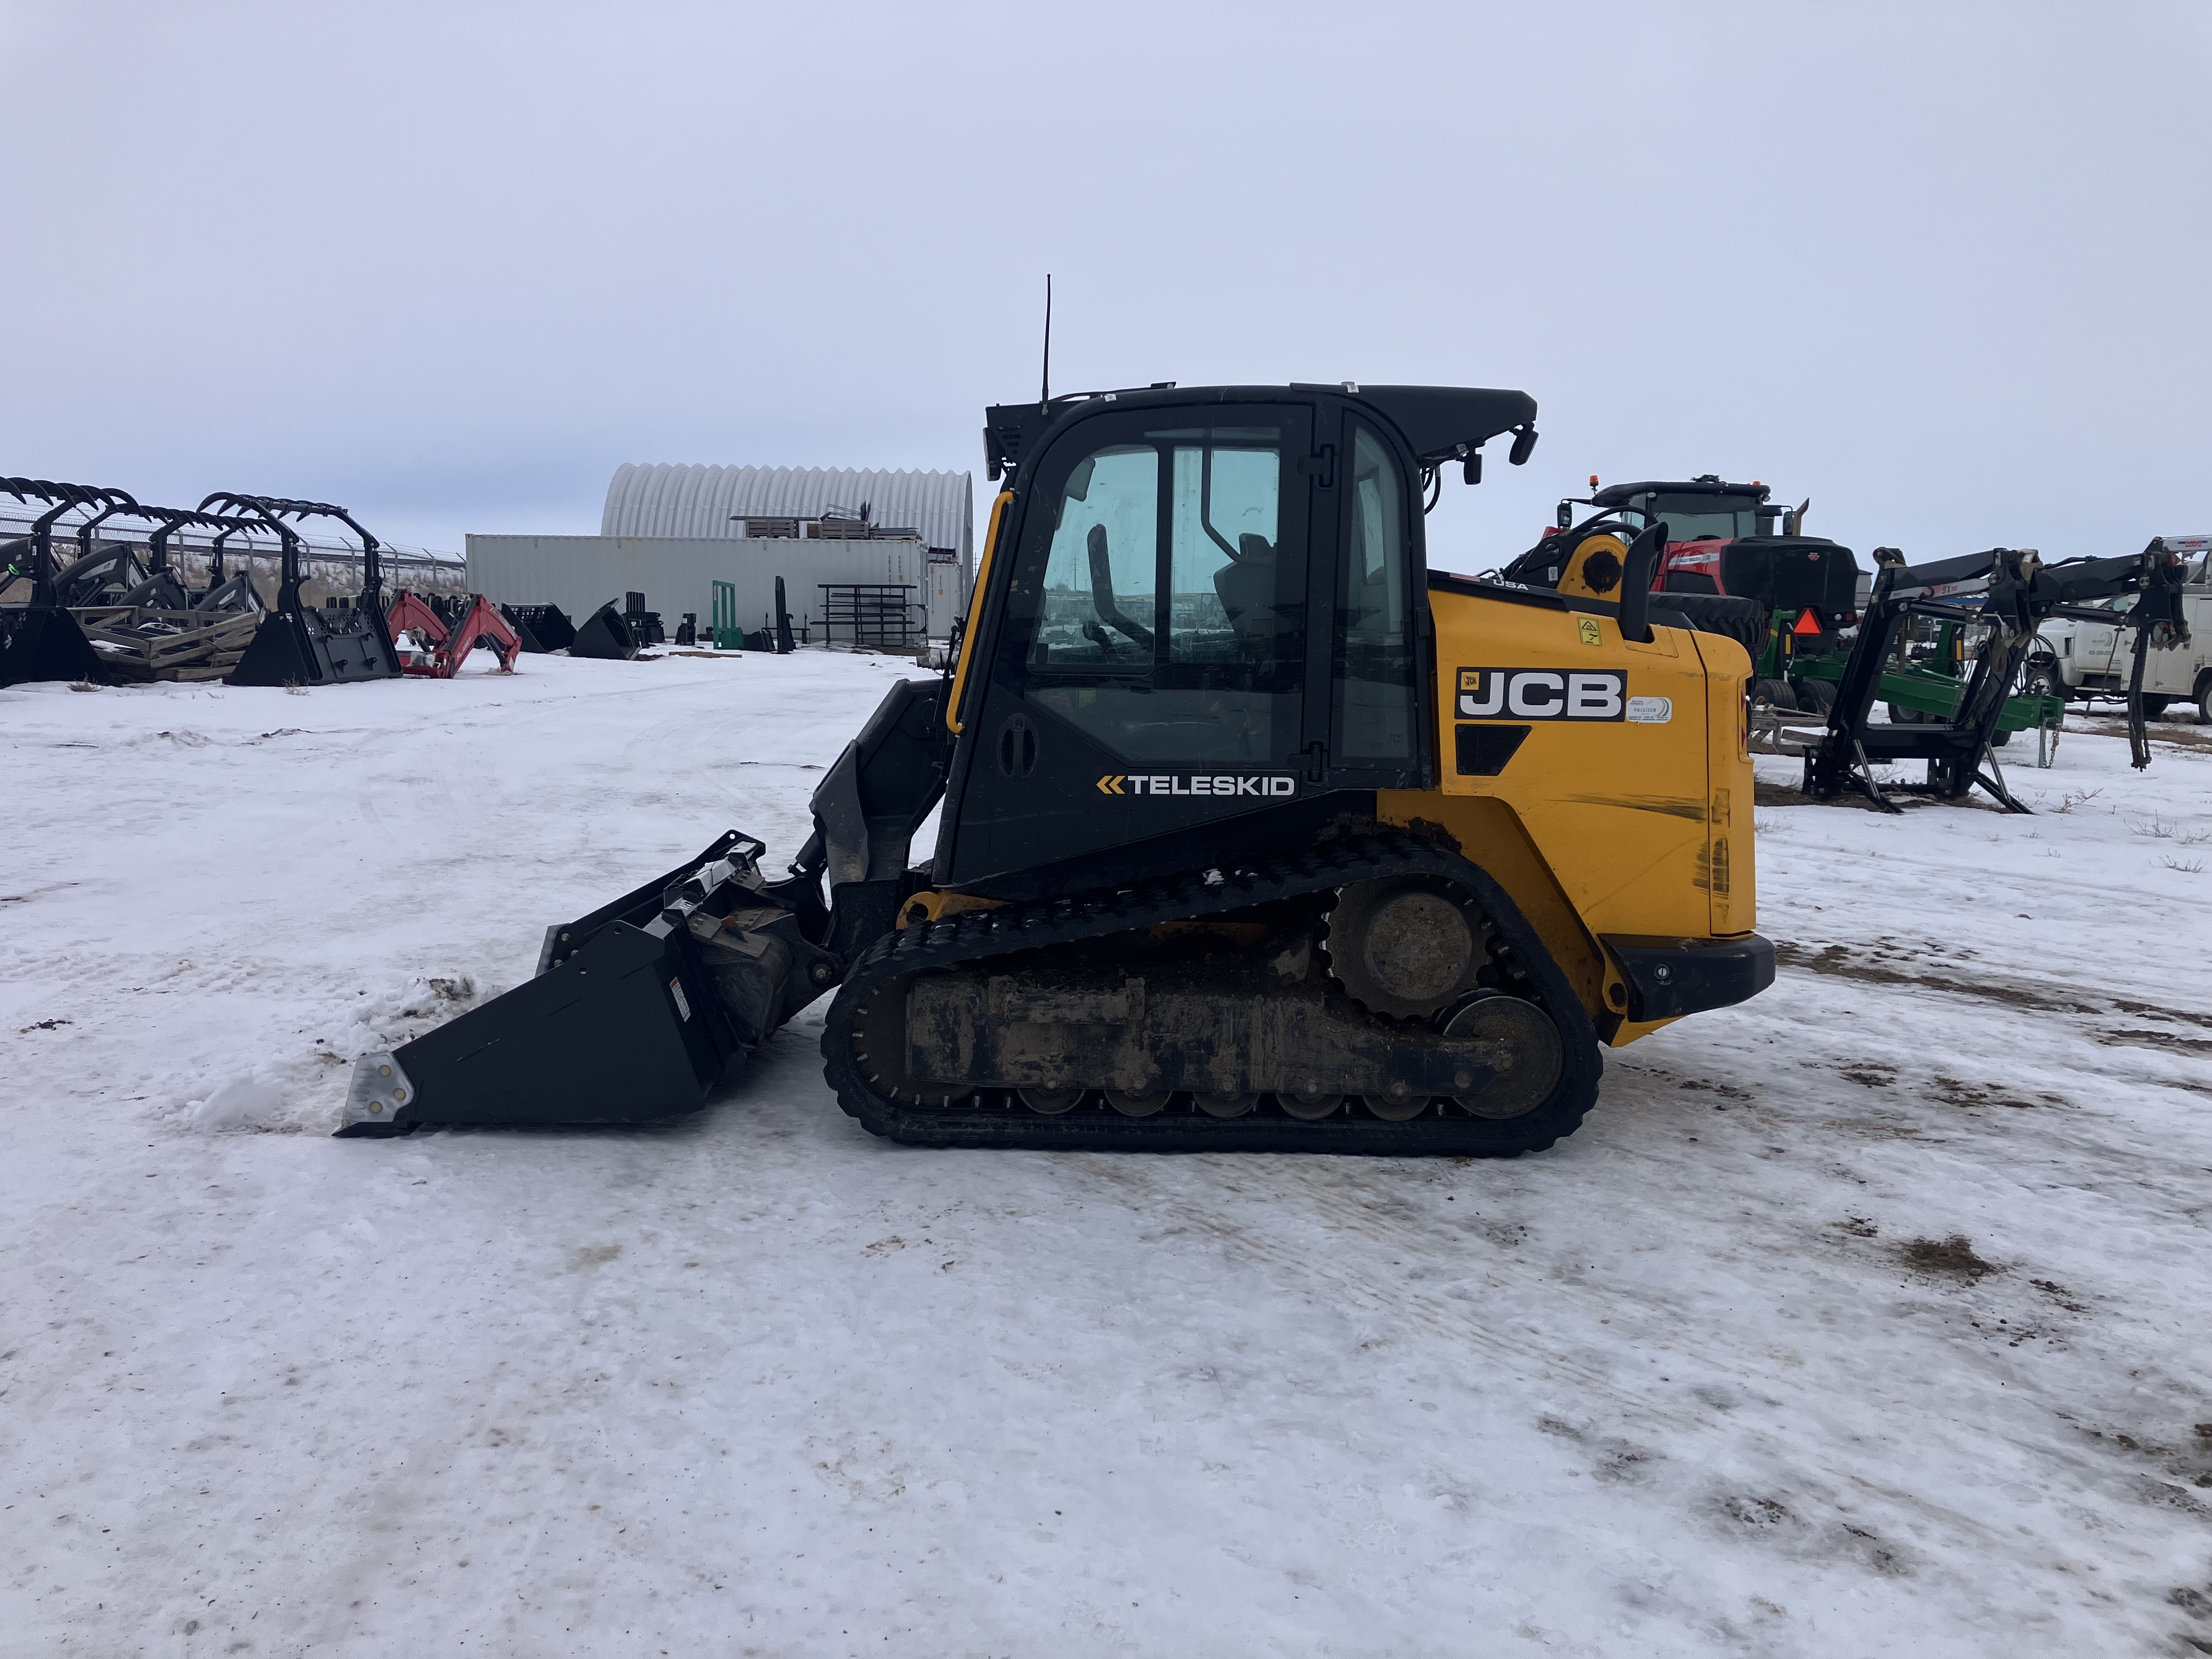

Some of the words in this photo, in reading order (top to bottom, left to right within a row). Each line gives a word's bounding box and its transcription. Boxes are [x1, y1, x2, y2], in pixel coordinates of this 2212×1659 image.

[1493, 579, 1530, 591] USA
[1466, 676, 1477, 685] JCB
[1460, 672, 1622, 716] JCB
[1127, 775, 1295, 795] TELESKID
